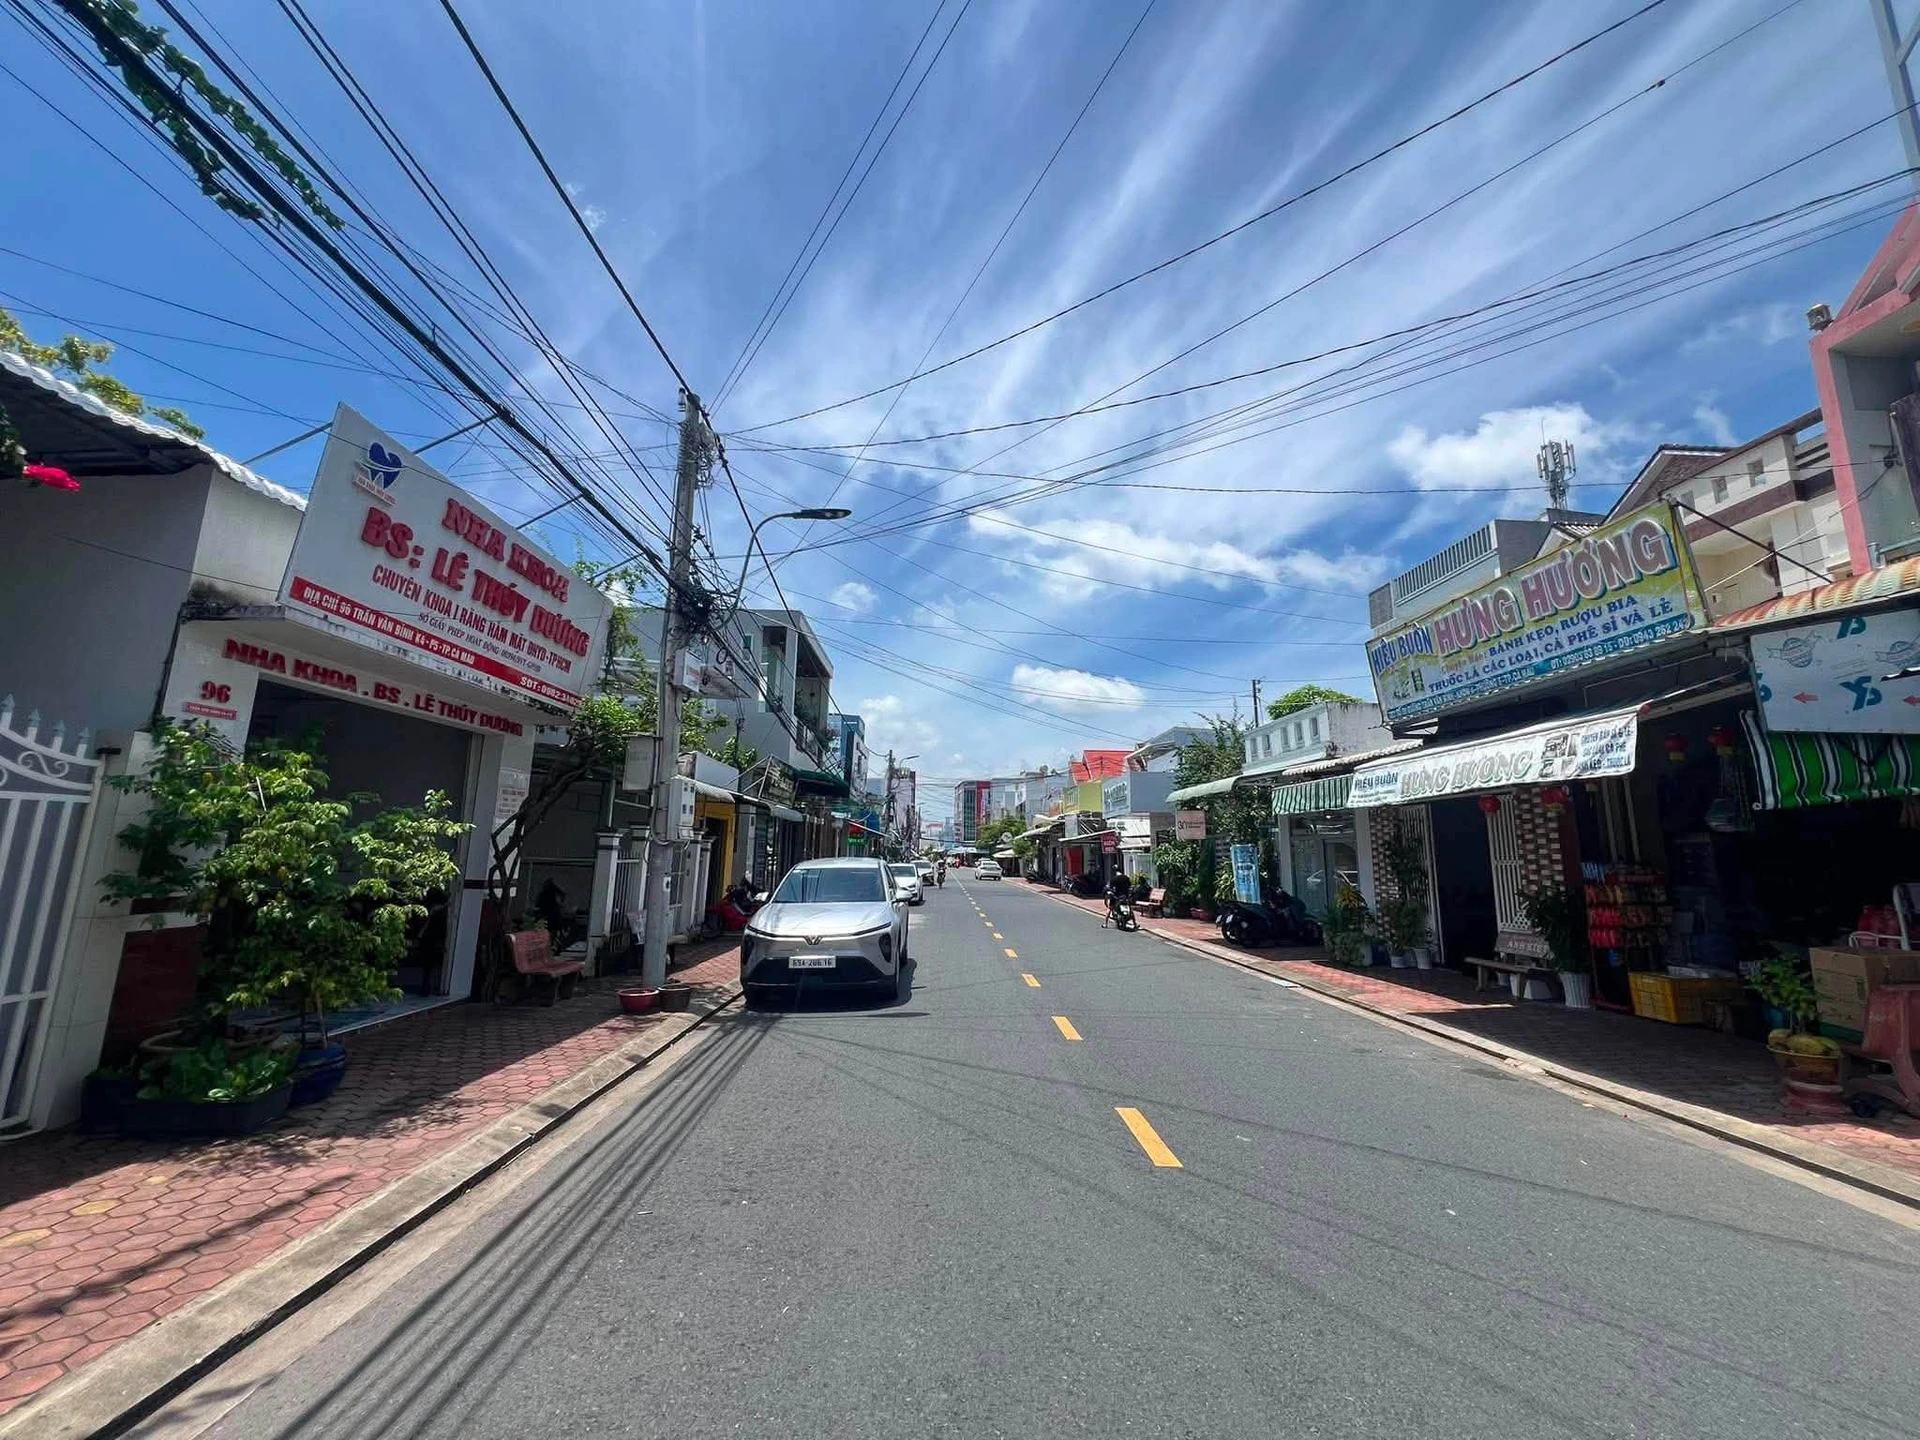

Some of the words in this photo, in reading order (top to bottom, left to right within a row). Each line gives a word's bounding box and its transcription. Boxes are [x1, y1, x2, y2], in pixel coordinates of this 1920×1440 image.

[303, 586, 321, 604] ĐỊA
[361, 506, 424, 568] BS:
[431, 547, 470, 591] LÊ
[530, 604, 590, 657] DƯƠNG
[442, 497, 507, 561] NHA
[507, 543, 570, 603] KHOA
[1370, 637, 1396, 676] HIỆU
[1398, 621, 1433, 656] BUÔN
[1434, 586, 1524, 657] HƯNG
[1520, 518, 1678, 622] HƯƠNG
[372, 564, 422, 602] CHUYÊN
[423, 588, 454, 618] KHOA
[459, 606, 487, 633] RĂNG
[487, 620, 511, 644] HÀM
[1428, 673, 1464, 693] THUỐC
[1465, 668, 1480, 681] LÁ
[1483, 657, 1507, 674] CÁC
[1545, 637, 1564, 654] CÀ
[1568, 626, 1599, 649] PHÊ
[1621, 608, 1645, 626] VÀ
[1649, 596, 1673, 618] LẺ
[1488, 636, 1525, 657] BÁNH
[1561, 604, 1604, 633] RƯỢU
[1607, 594, 1638, 613] BIA
[200, 680, 231, 703] 96
[223, 638, 286, 674] NHA
[292, 658, 358, 693] KHOA
[414, 693, 436, 713] LÊ
[479, 713, 523, 737] DƯƠNG
